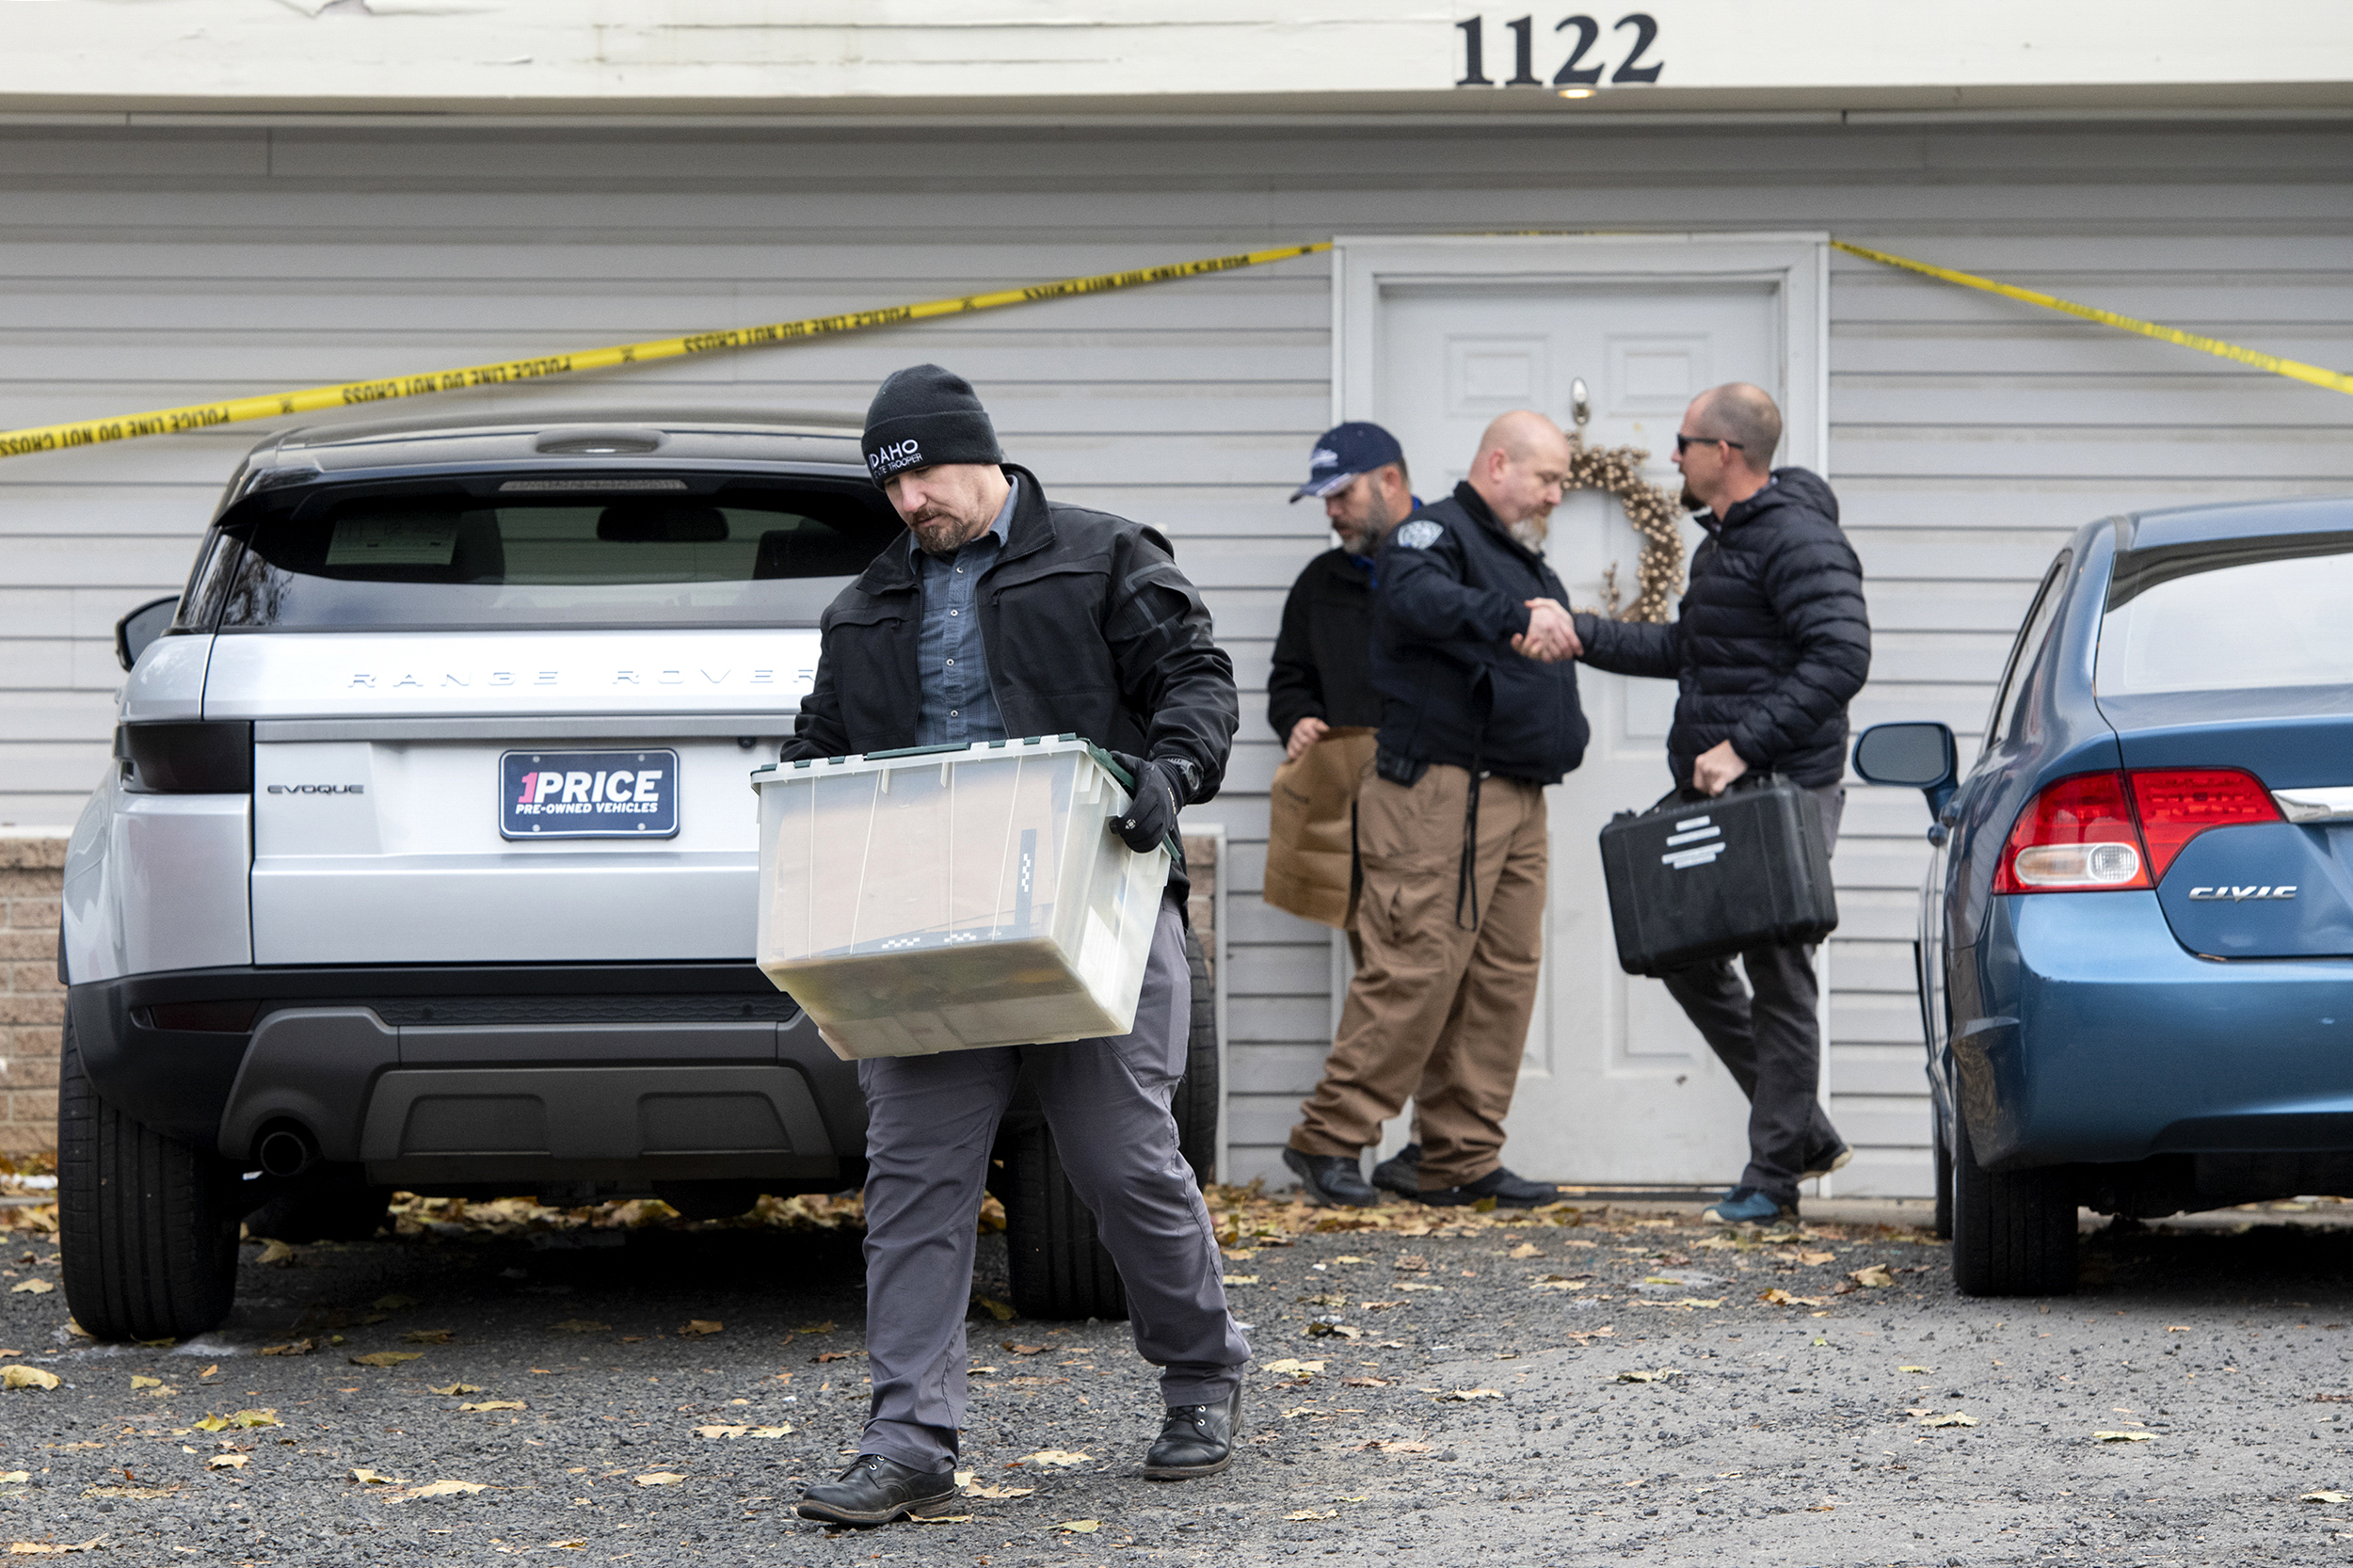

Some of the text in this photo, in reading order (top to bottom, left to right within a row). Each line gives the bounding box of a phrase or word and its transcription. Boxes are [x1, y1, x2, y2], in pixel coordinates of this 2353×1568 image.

[1455, 13, 1664, 85] 1122
[343, 356, 572, 404] POLICE LINE DO NOT CROSS
[0, 407, 230, 456] POLICE LINE DO NOT CROSS
[888, 452, 923, 472] TROOPER
[347, 668, 816, 688] RANGE ROVER
[267, 784, 364, 796] EVOQUE
[518, 770, 663, 804] 1PRICE
[515, 802, 658, 815] PRE-OWNED VEHICLES
[2188, 886, 2297, 903] CIVIC
